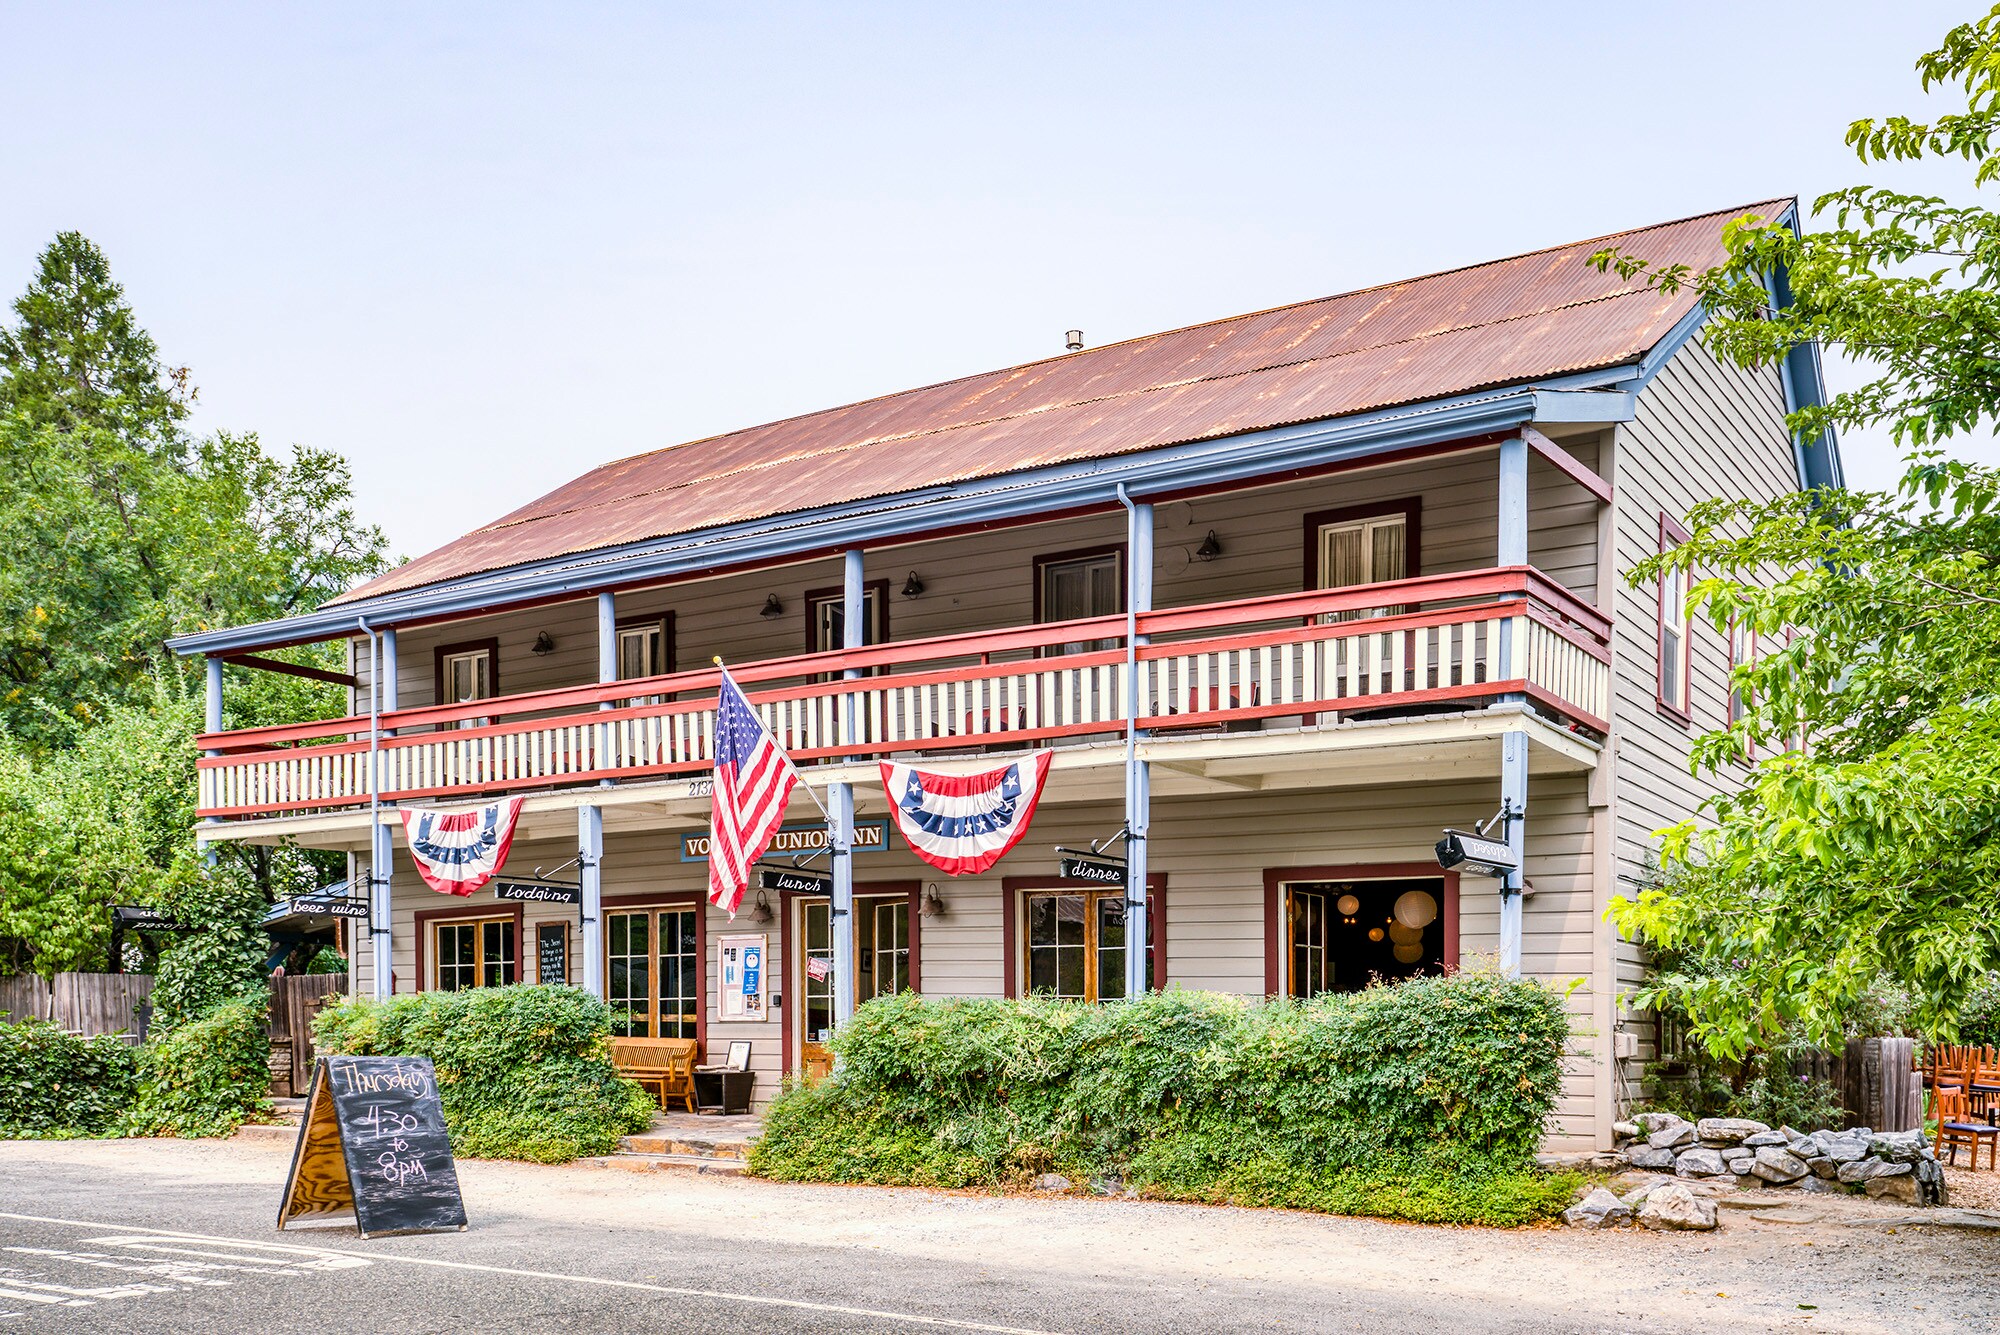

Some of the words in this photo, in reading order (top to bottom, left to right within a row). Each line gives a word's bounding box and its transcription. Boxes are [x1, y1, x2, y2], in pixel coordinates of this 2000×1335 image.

[852, 827, 881, 845] NN
[1071, 860, 1121, 881] dinner
[777, 873, 820, 892] lunch
[293, 900, 326, 914] beer
[331, 904, 368, 916] wine
[335, 1063, 428, 1099] Thursday
[387, 1137, 409, 1152] to
